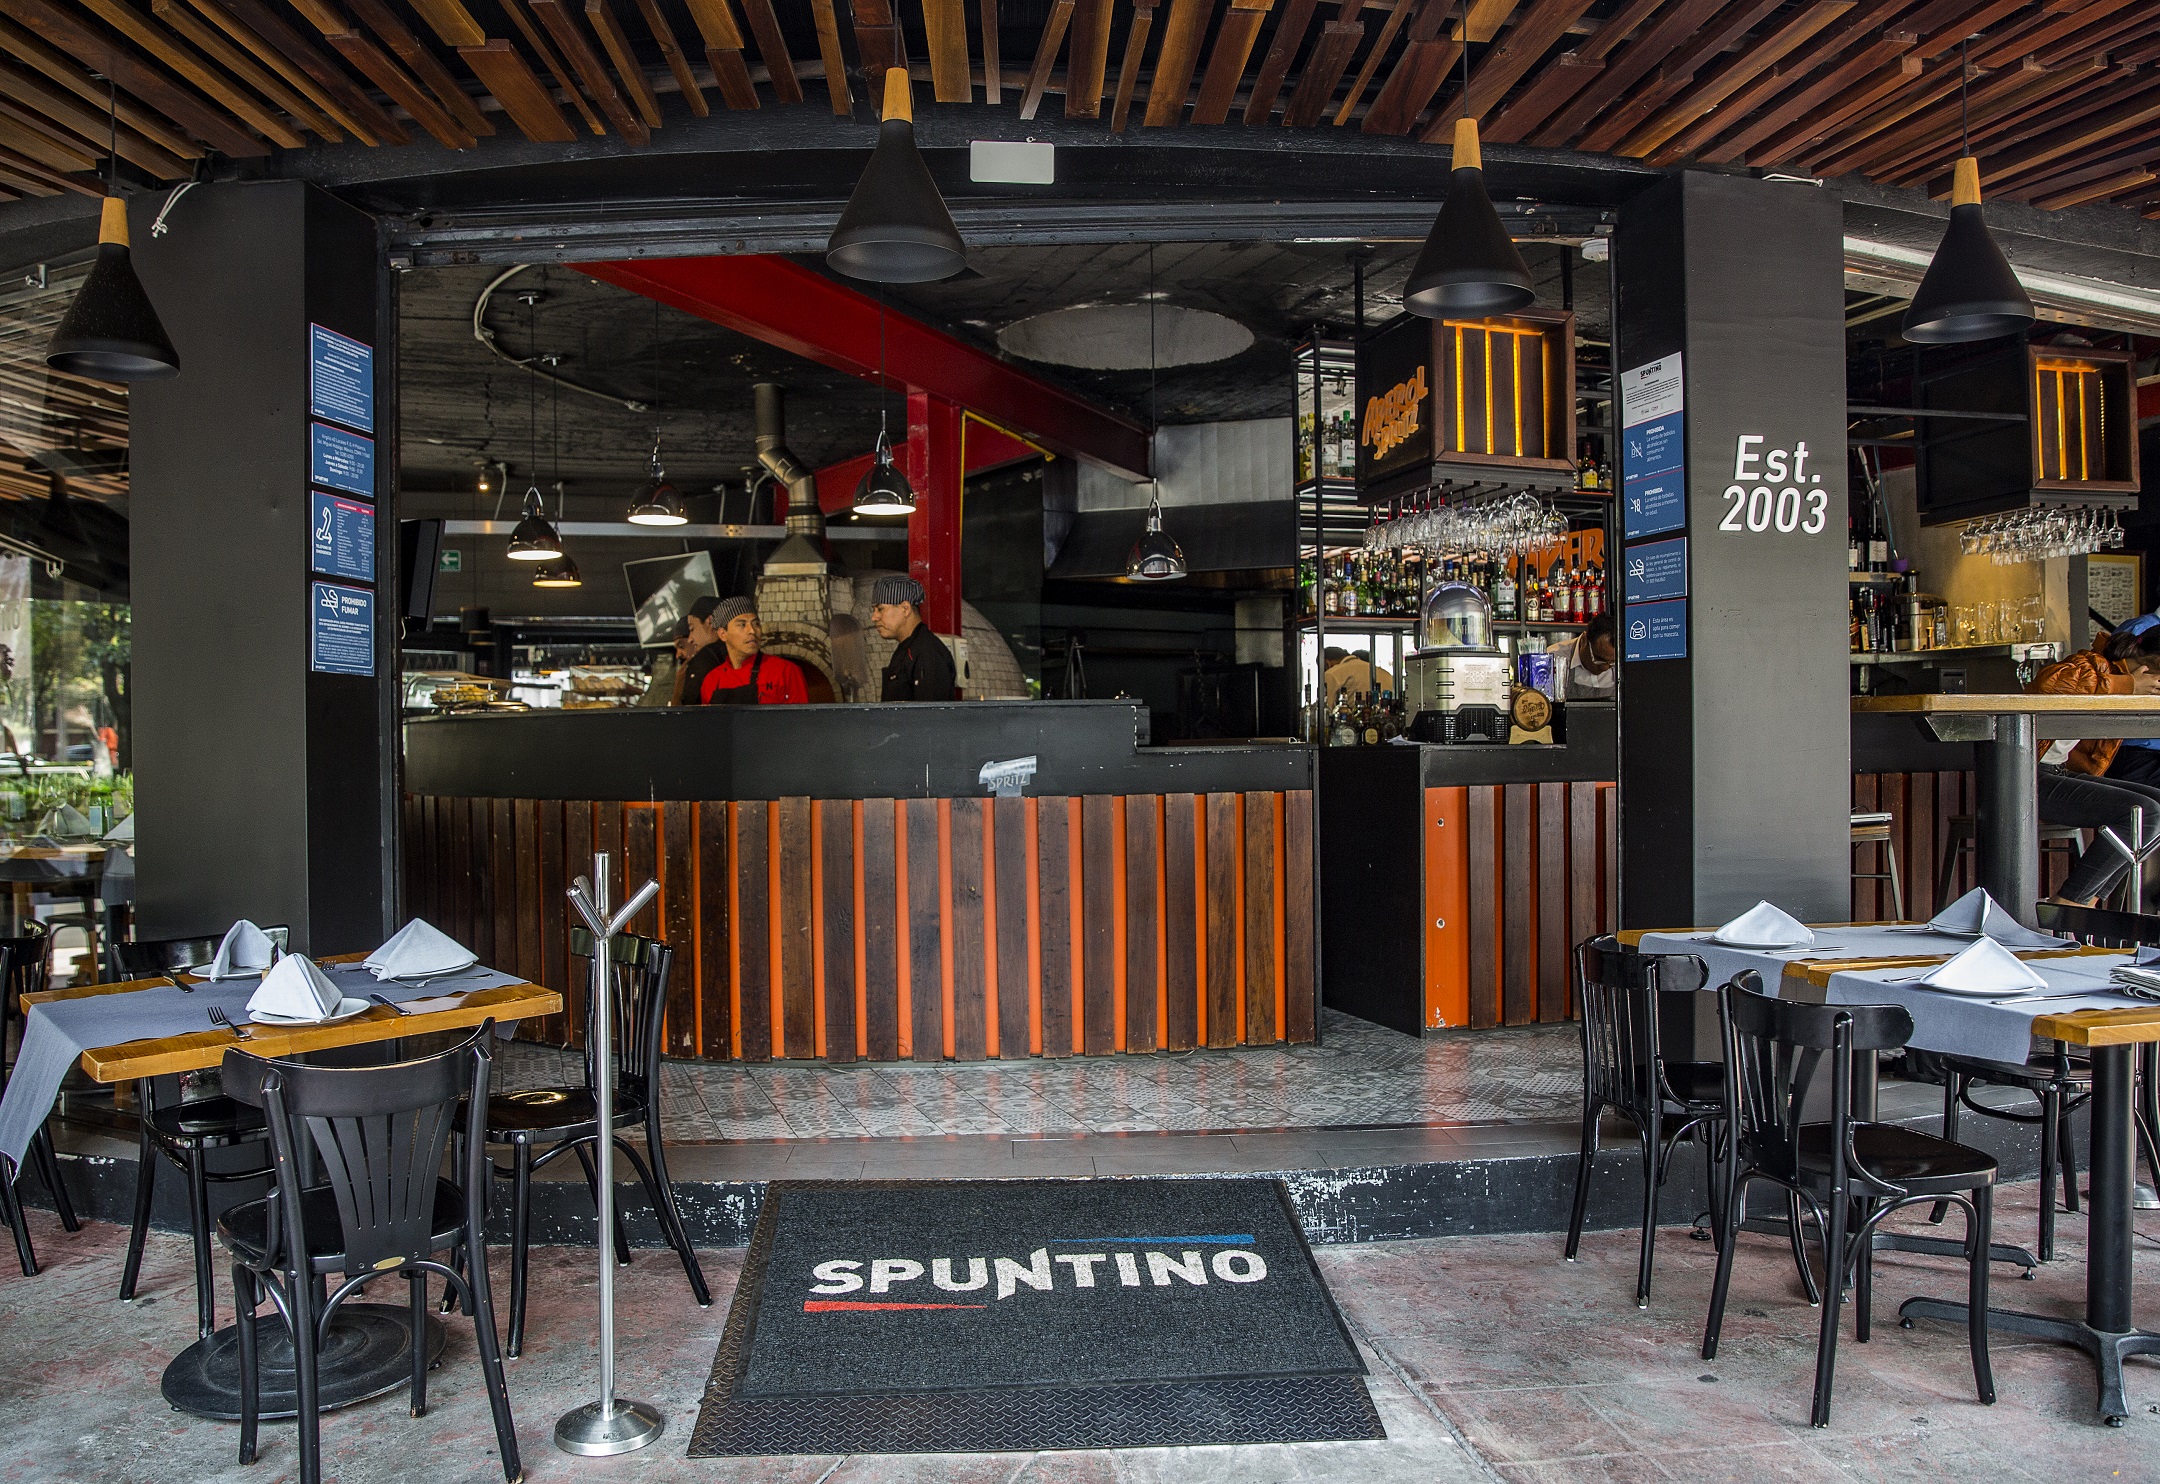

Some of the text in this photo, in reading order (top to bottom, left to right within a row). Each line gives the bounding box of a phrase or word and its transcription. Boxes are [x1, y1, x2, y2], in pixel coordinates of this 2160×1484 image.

[1362, 366, 1428, 446] APEROL
[1735, 435, 1821, 483] Est.
[1718, 485, 1828, 534] 2003
[342, 596, 367, 607] PROHIBIDO
[342, 606, 359, 615] FUMAR
[989, 773, 1026, 789] SPRITZ
[808, 1247, 1268, 1300] SPUNTINO
